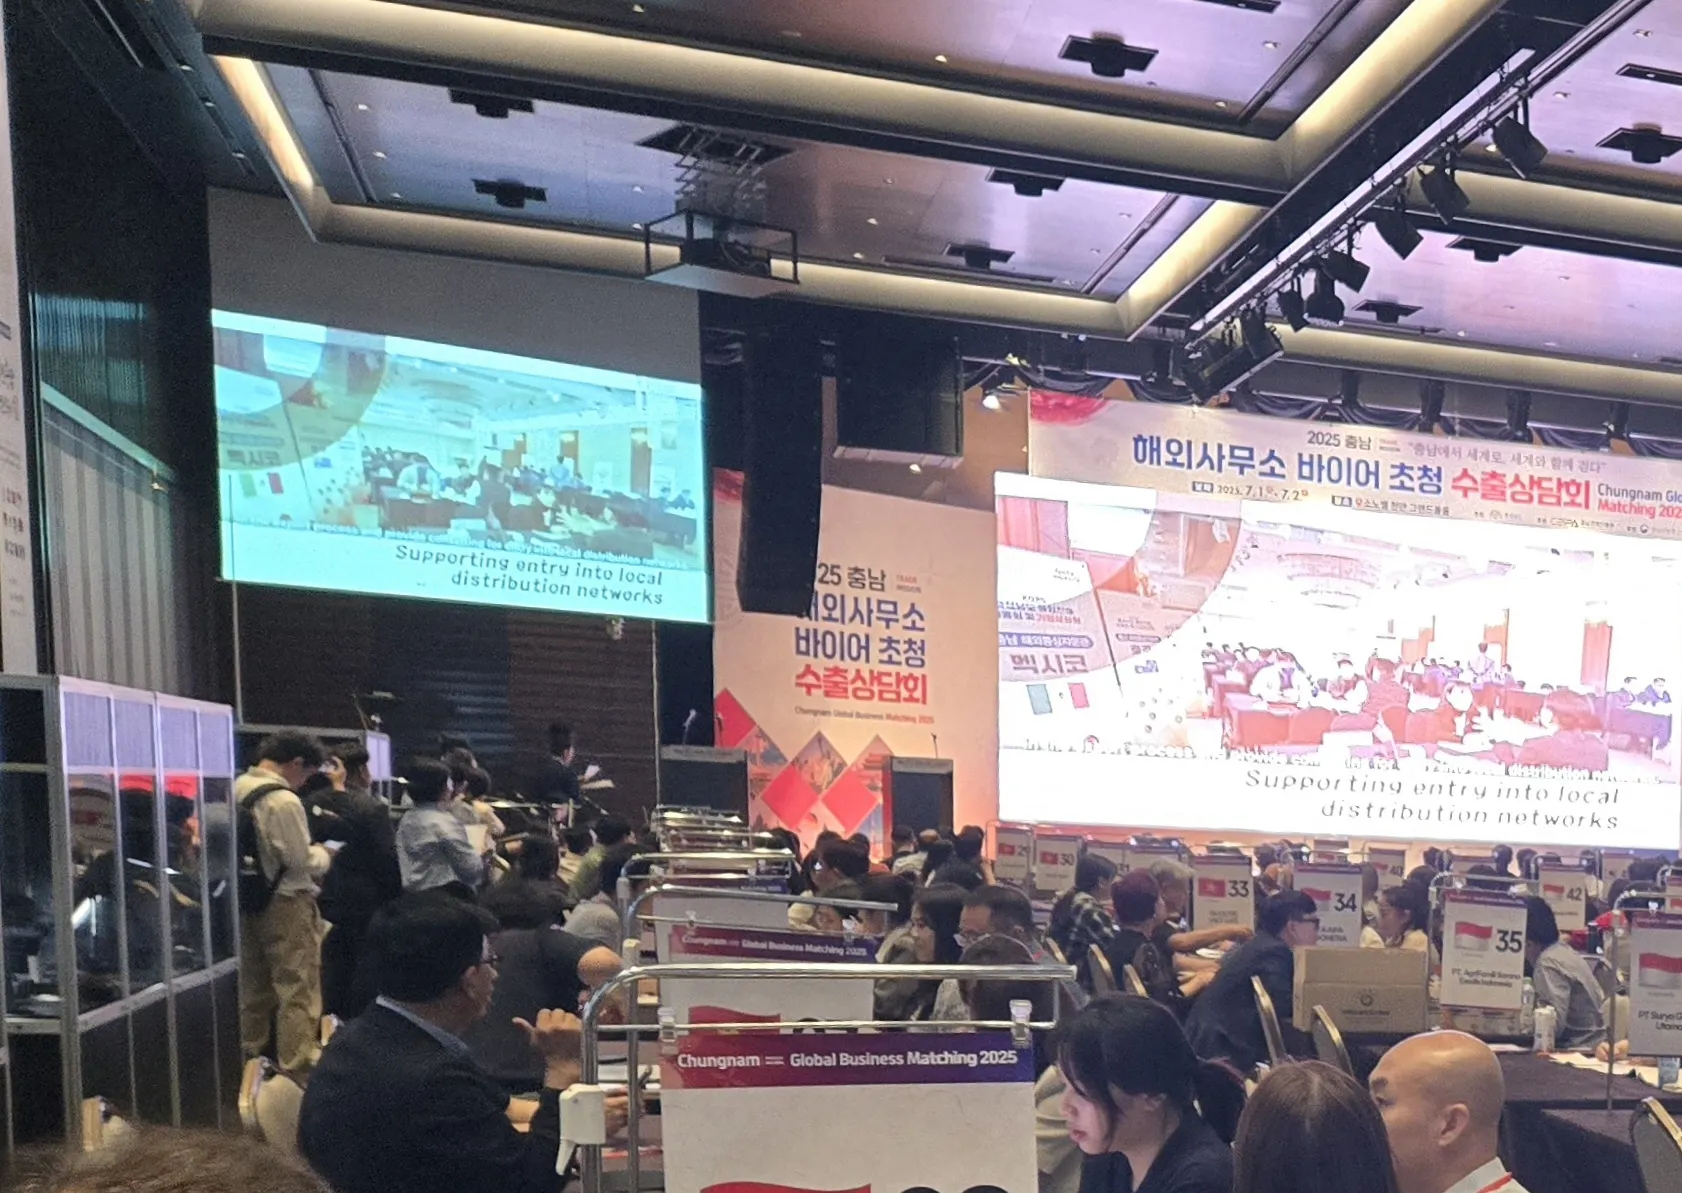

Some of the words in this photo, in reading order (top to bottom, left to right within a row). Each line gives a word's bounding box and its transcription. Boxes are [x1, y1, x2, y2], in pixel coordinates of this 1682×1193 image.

[1307, 430, 1341, 447] 2025
[1344, 434, 1372, 451] 충남
[1133, 434, 1287, 480] 해외사무소
[1297, 452, 1381, 490] 바이어
[1389, 463, 1443, 495] 초청
[1451, 467, 1591, 511] 수출상담회
[1597, 483, 1663, 503] Chungnam
[1597, 499, 1657, 520] Matching
[395, 544, 509, 571] Supporting
[516, 559, 569, 577] entry
[575, 561, 613, 580] into
[618, 567, 663, 586] local
[451, 570, 570, 597] distribution
[577, 584, 663, 605] networks
[818, 562, 842, 586] 25
[848, 566, 886, 592] 충남
[795, 626, 870, 664] 바이어
[879, 636, 926, 668] 초청
[795, 663, 927, 705] 수출상담회
[1245, 768, 1402, 796] Supporting
[1413, 781, 1487, 799] entry
[1498, 785, 1549, 802] into
[1559, 786, 1619, 805] local
[1322, 799, 1488, 824] distribution
[1498, 809, 1619, 830] networks
[1060, 852, 1075, 866] 30
[1228, 879, 1249, 898] 33
[1566, 887, 1582, 901] 42
[1333, 893, 1357, 912] 34
[682, 934, 727, 946] Chungnam
[741, 938, 768, 949] Global
[769, 940, 804, 951] Business
[805, 942, 844, 956] Matching
[845, 946, 867, 956] 2025
[1495, 928, 1523, 953] 35
[677, 1053, 760, 1070] Chungnam
[789, 1052, 836, 1068] Global
[839, 1051, 904, 1068] Business
[906, 1049, 977, 1067] Matching
[979, 1049, 1018, 1066] 2025
